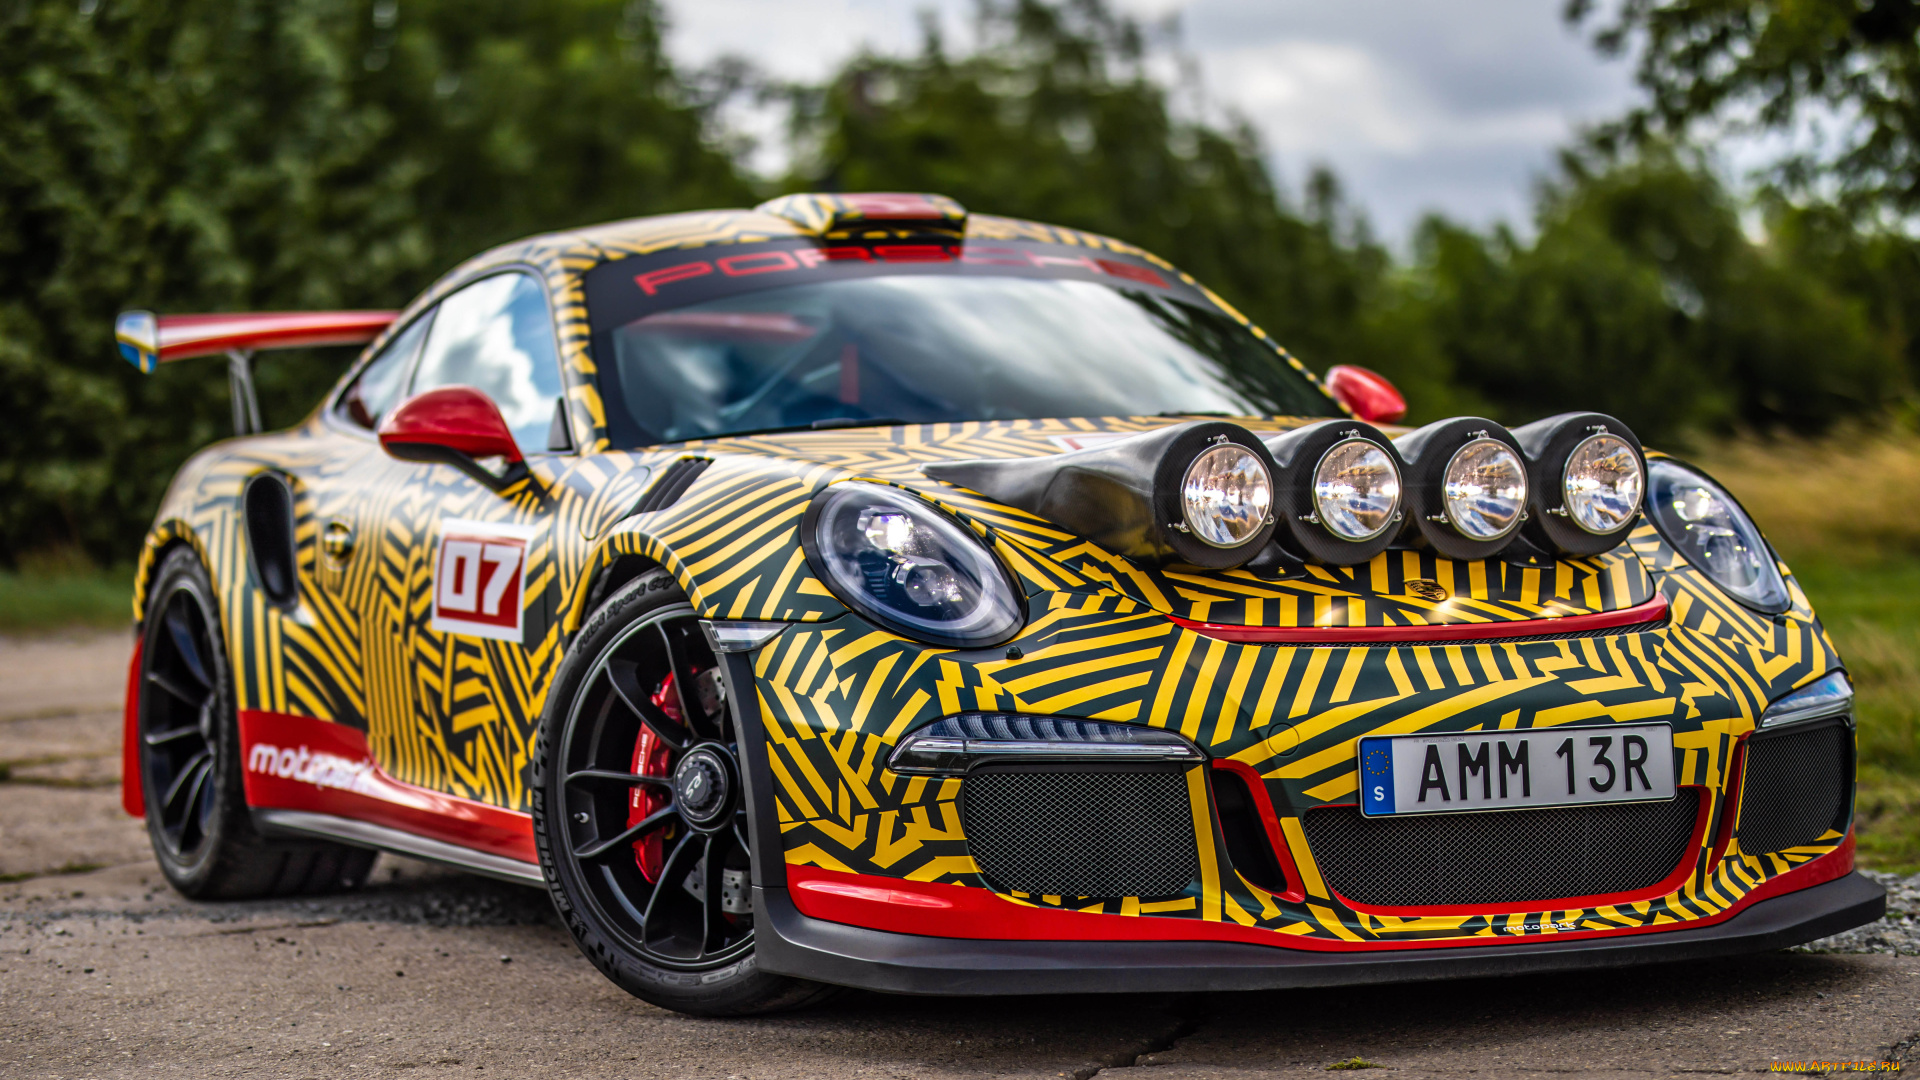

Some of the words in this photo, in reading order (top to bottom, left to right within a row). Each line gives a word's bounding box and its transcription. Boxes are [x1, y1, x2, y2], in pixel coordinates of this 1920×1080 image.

[439, 541, 522, 616] 07
[606, 582, 647, 620] Sport
[647, 576, 676, 593] Cup
[633, 733, 648, 808] POSCHE
[1374, 786, 1384, 801] S
[1417, 740, 1531, 802] AMM
[1555, 735, 1651, 794] 13R
[534, 787, 571, 912] MICHELIN
[1503, 922, 1577, 932] motopark
